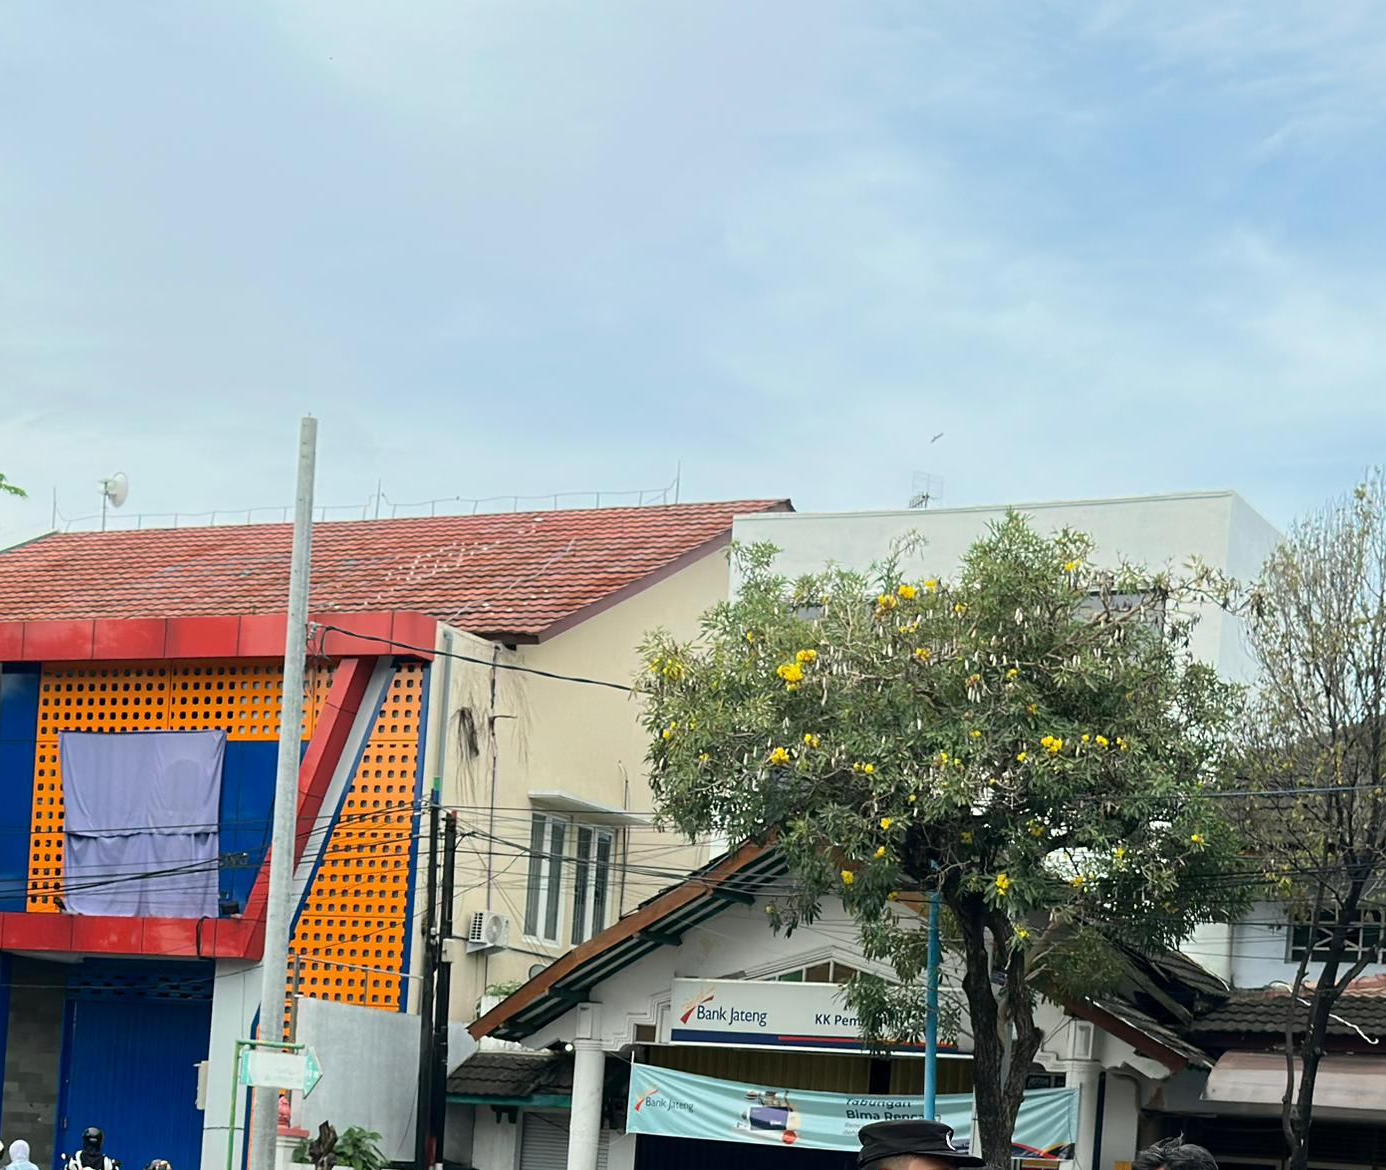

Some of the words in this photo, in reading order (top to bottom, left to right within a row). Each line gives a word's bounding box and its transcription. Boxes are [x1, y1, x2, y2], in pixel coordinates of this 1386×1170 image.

[697, 1005, 727, 1022] Bank
[729, 1007, 767, 1027] Jateng
[815, 1014, 831, 1025] KK
[646, 1097, 666, 1108] Bank
[668, 1099, 694, 1111] Jateng
[846, 1109, 881, 1121] Bima
